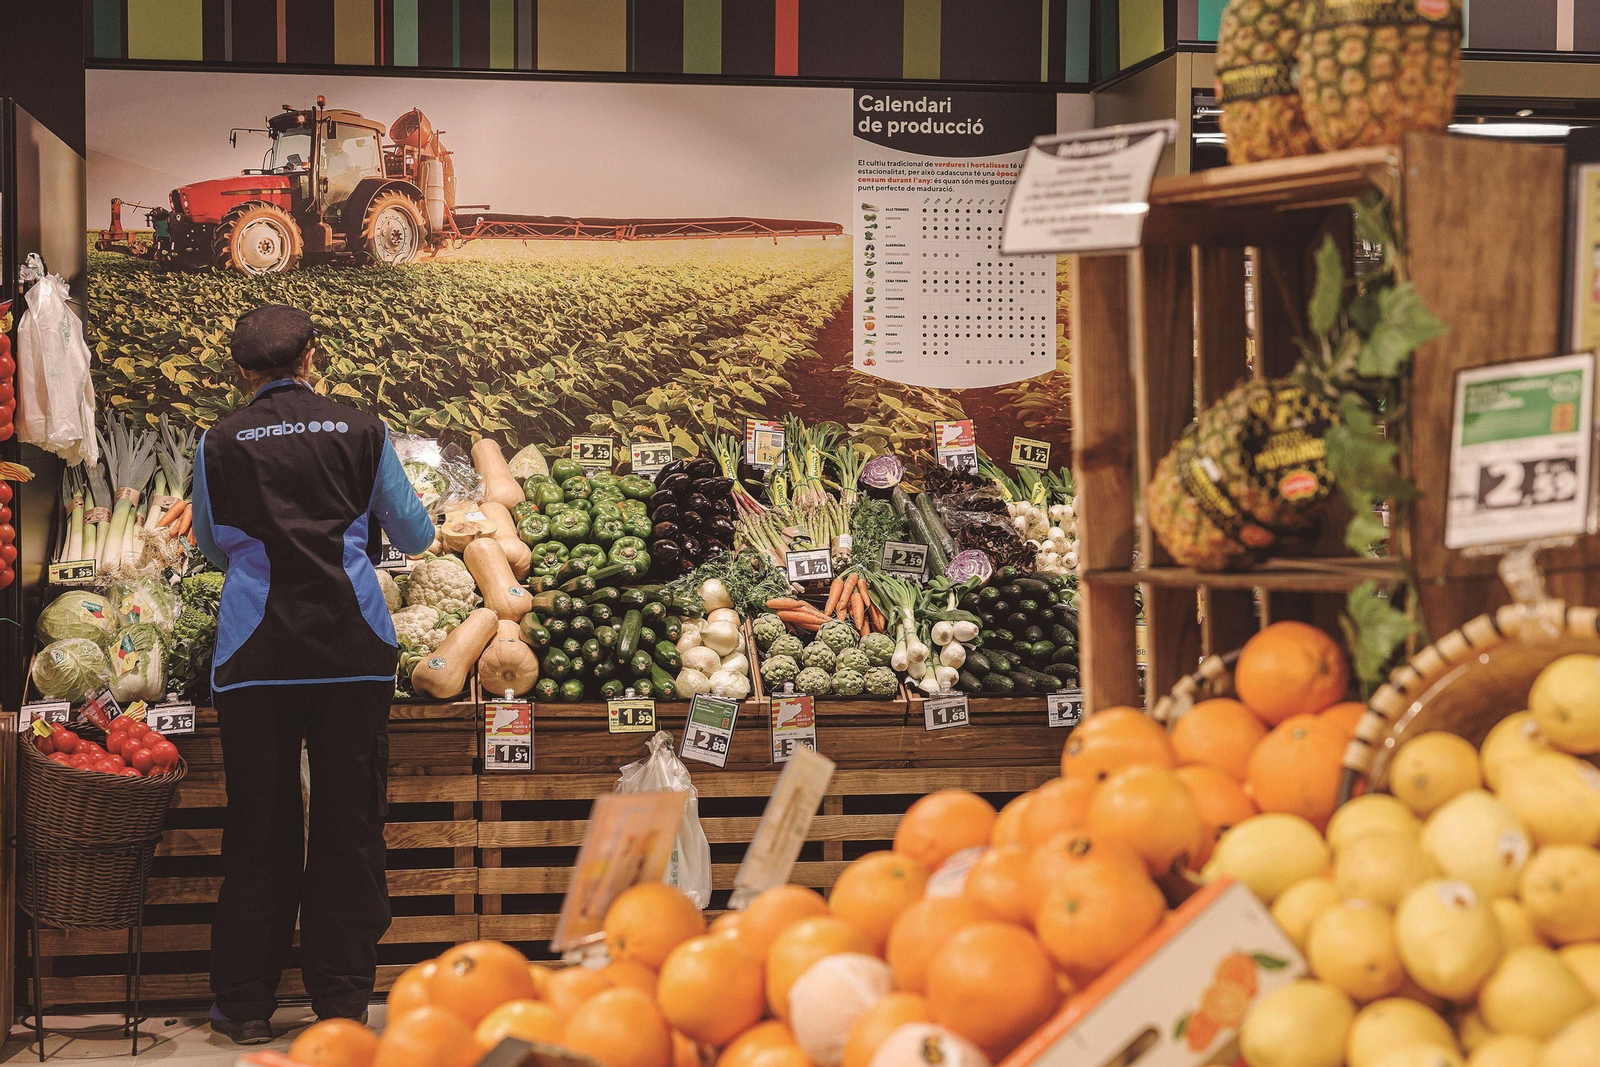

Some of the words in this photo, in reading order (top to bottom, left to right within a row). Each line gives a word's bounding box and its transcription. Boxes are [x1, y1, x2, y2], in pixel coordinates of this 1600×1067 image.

[858, 95, 952, 113] Calendari
[858, 117, 882, 132] de
[888, 118, 984, 137] producció
[236, 421, 306, 441] caprabo
[583, 443, 610, 459] 2,29
[645, 450, 670, 465] 2,59
[1023, 446, 1046, 462] 1,72
[895, 550, 922, 567] 2,59
[799, 560, 828, 575] 1,70
[161, 715, 192, 730] 2,16
[623, 708, 652, 725] 1,99
[937, 708, 966, 723] 1,68
[697, 731, 726, 753] 2,88
[499, 745, 528, 763] 1,91
